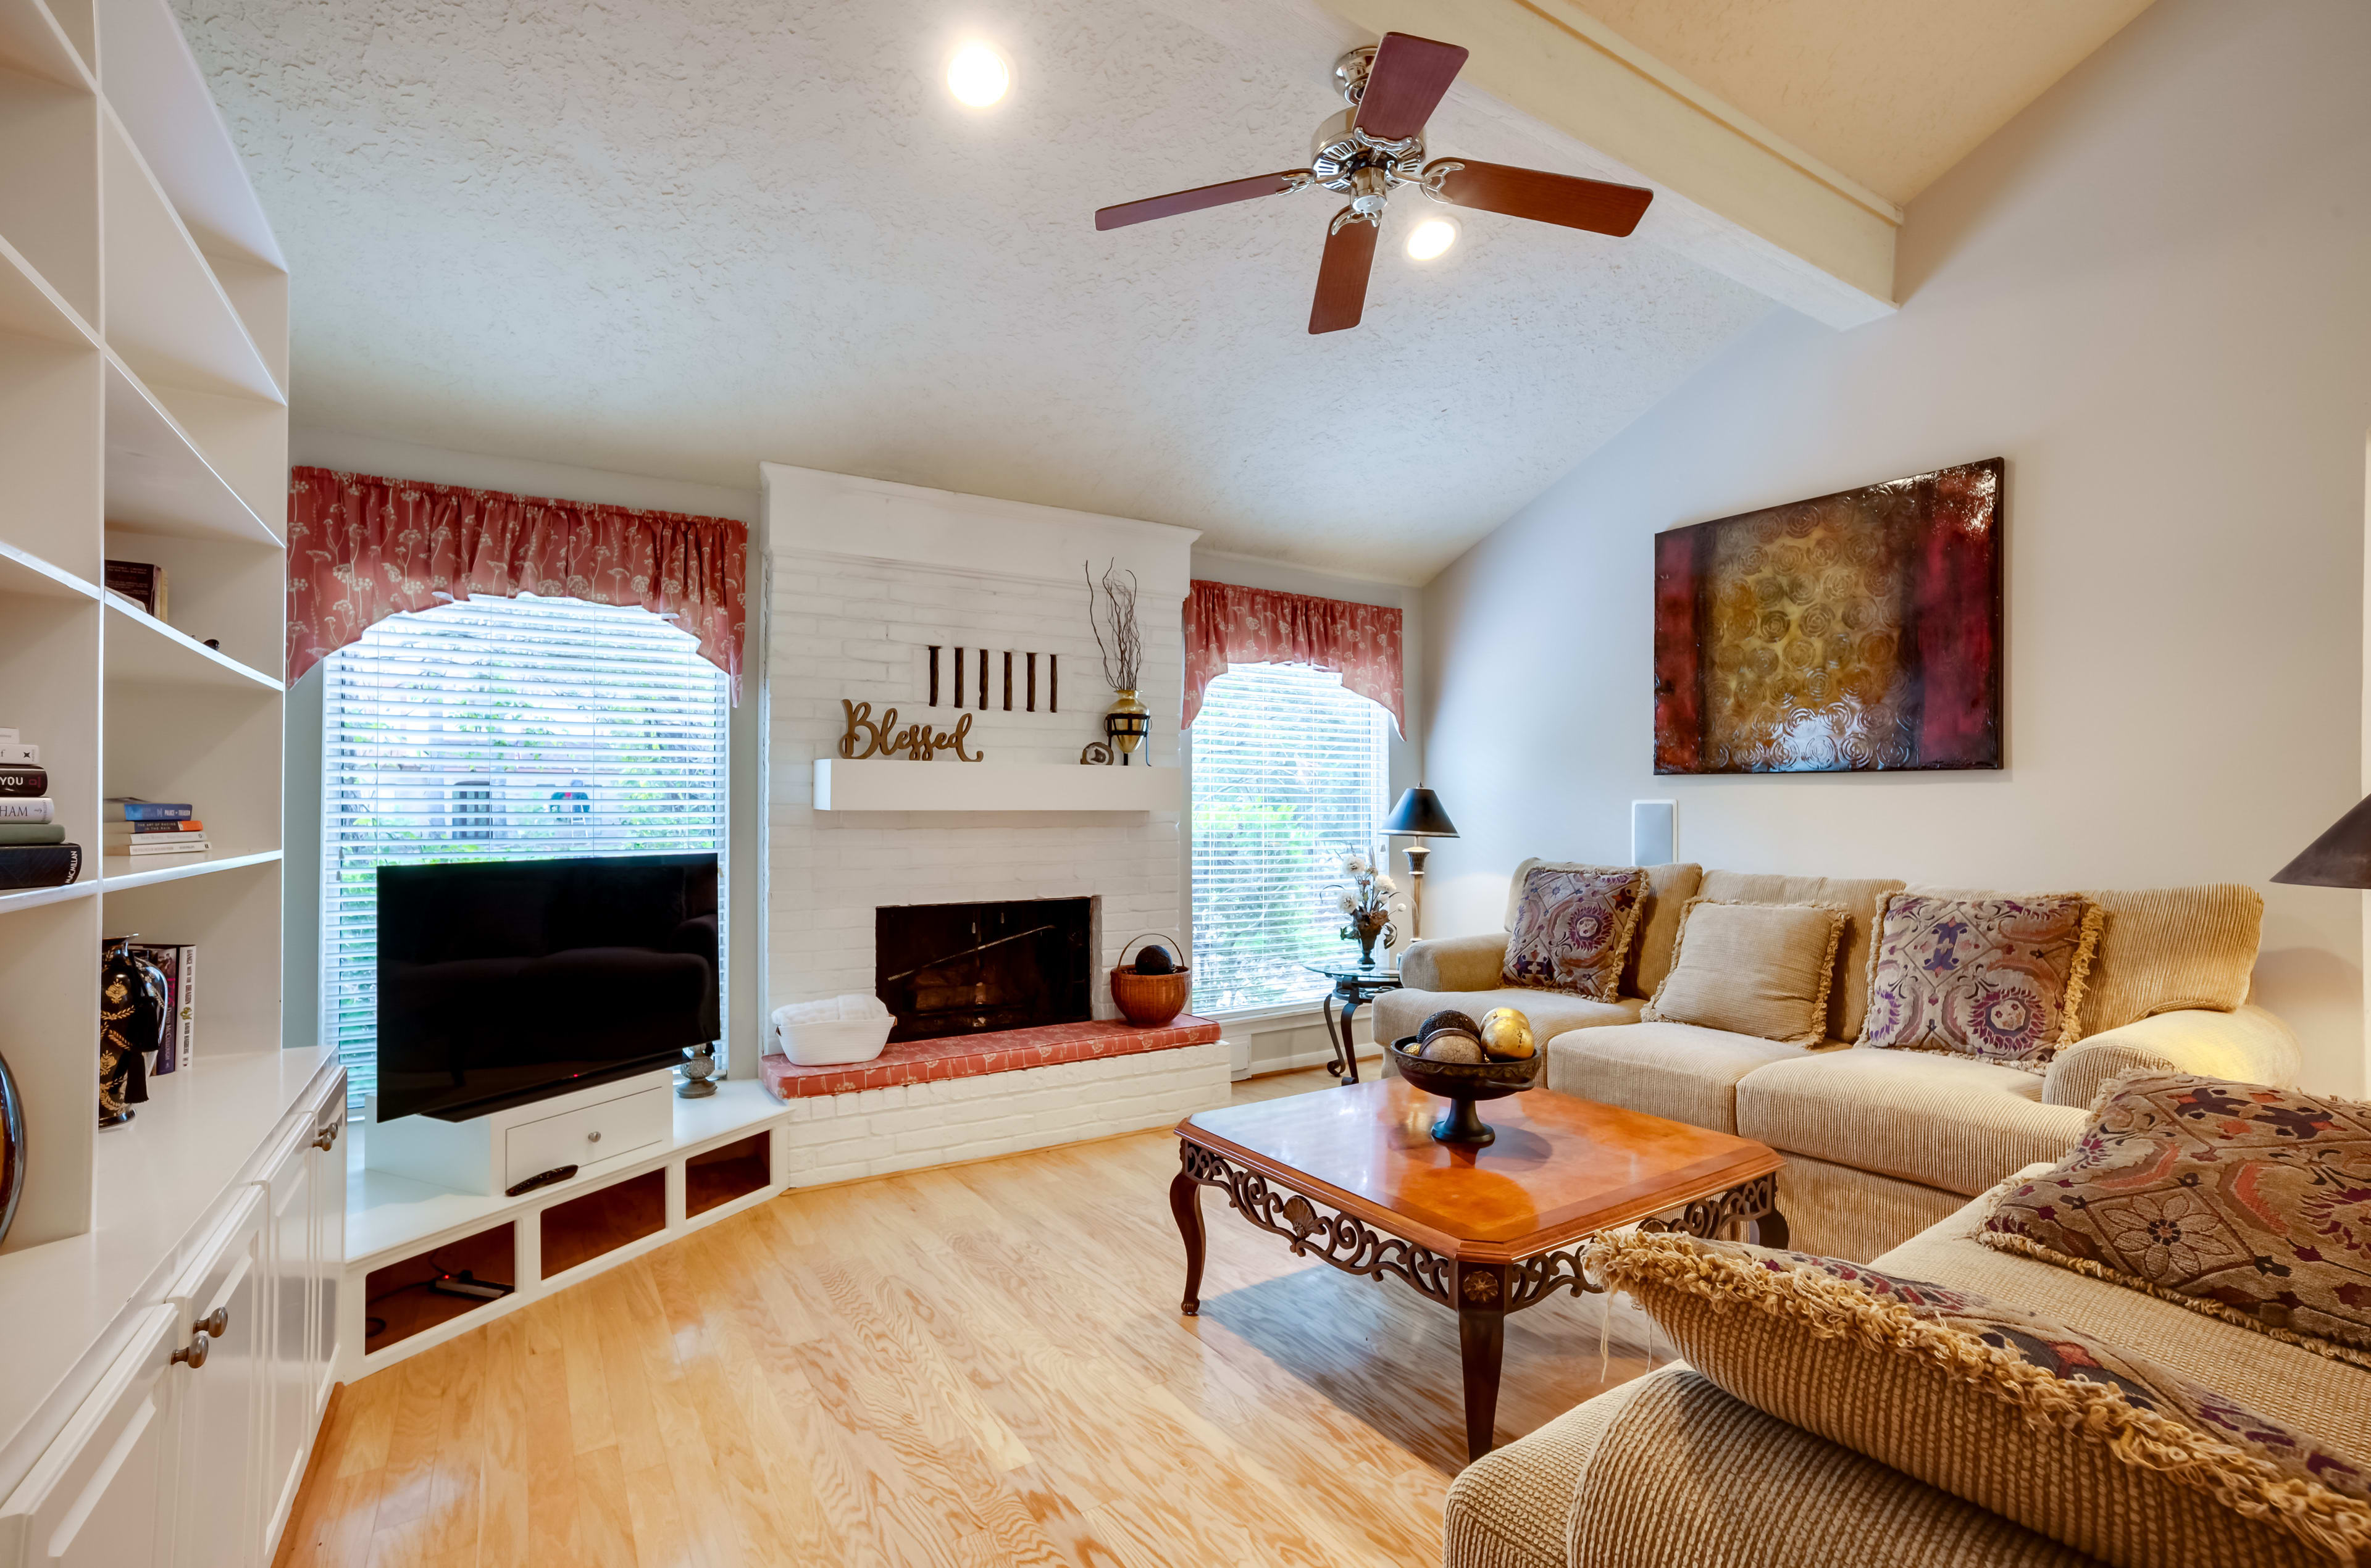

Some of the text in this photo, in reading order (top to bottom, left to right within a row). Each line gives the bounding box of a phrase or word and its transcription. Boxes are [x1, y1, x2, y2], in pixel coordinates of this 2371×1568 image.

[838, 699, 984, 762] Blessed
[0, 777, 23, 786] YOU
[0, 806, 28, 817] HAM
[65, 851, 78, 883] MACMILLAN
[167, 978, 175, 1007] 1776
